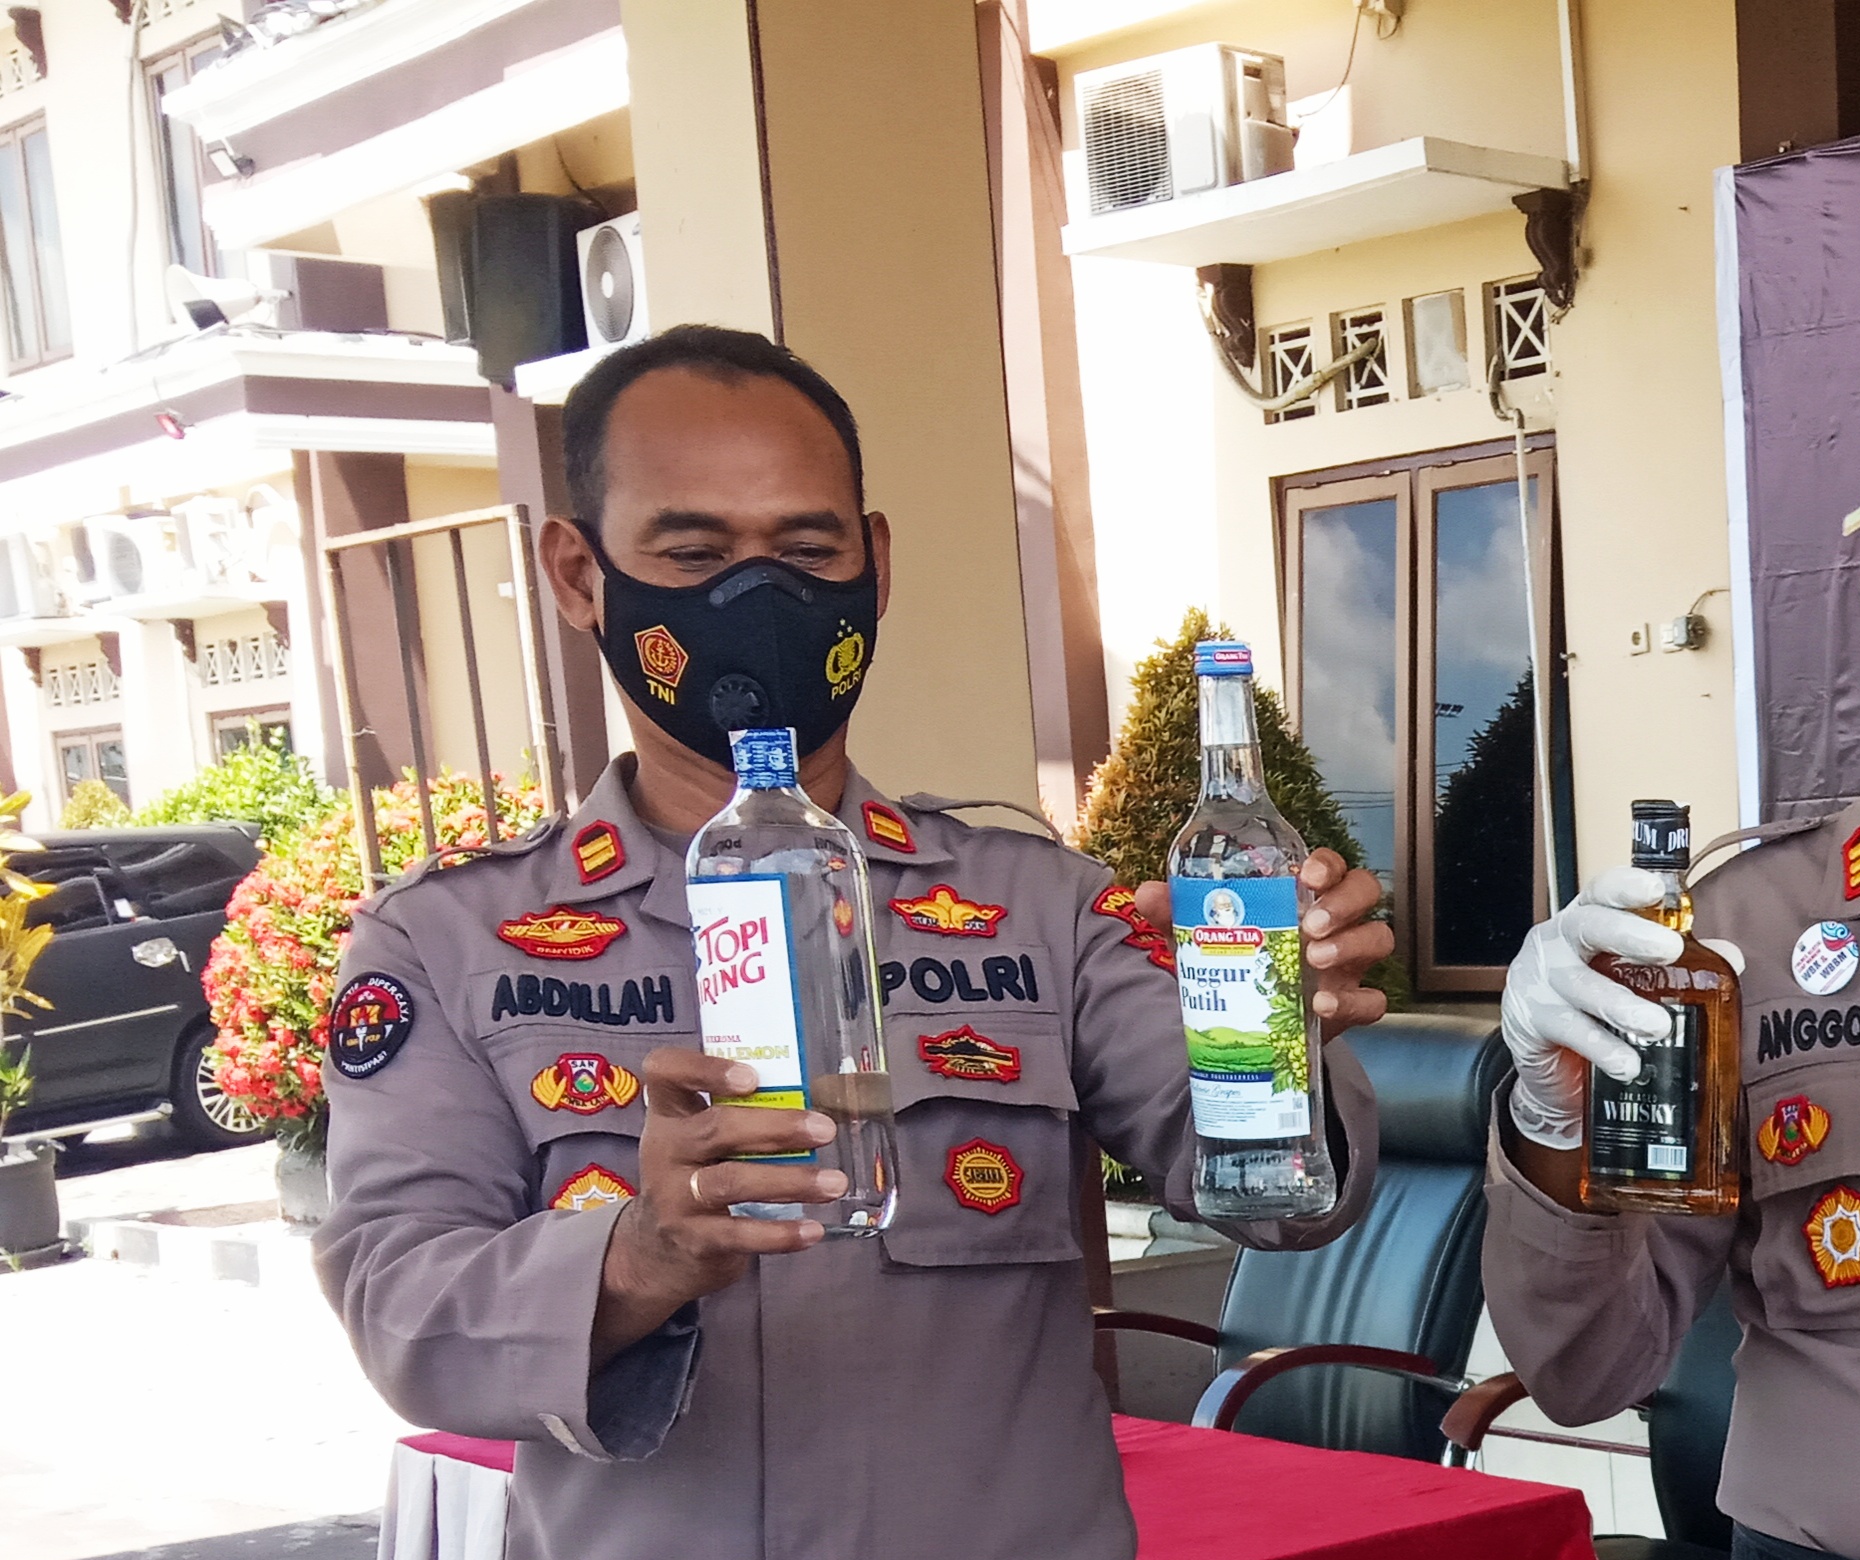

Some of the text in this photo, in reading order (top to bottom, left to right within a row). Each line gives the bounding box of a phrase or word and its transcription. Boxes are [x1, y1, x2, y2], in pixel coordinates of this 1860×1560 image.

[646, 679, 677, 706] TNI
[831, 668, 862, 701] POLRI
[698, 916, 769, 966] TOPI
[1195, 930, 1260, 943] ORANG TUA
[880, 953, 1039, 1006] POLRI
[1180, 963, 1251, 988] Anggur
[491, 973, 675, 1026] ABDILLAH
[1182, 986, 1227, 1013] Putih
[1603, 1100, 1677, 1126] WHISKY
